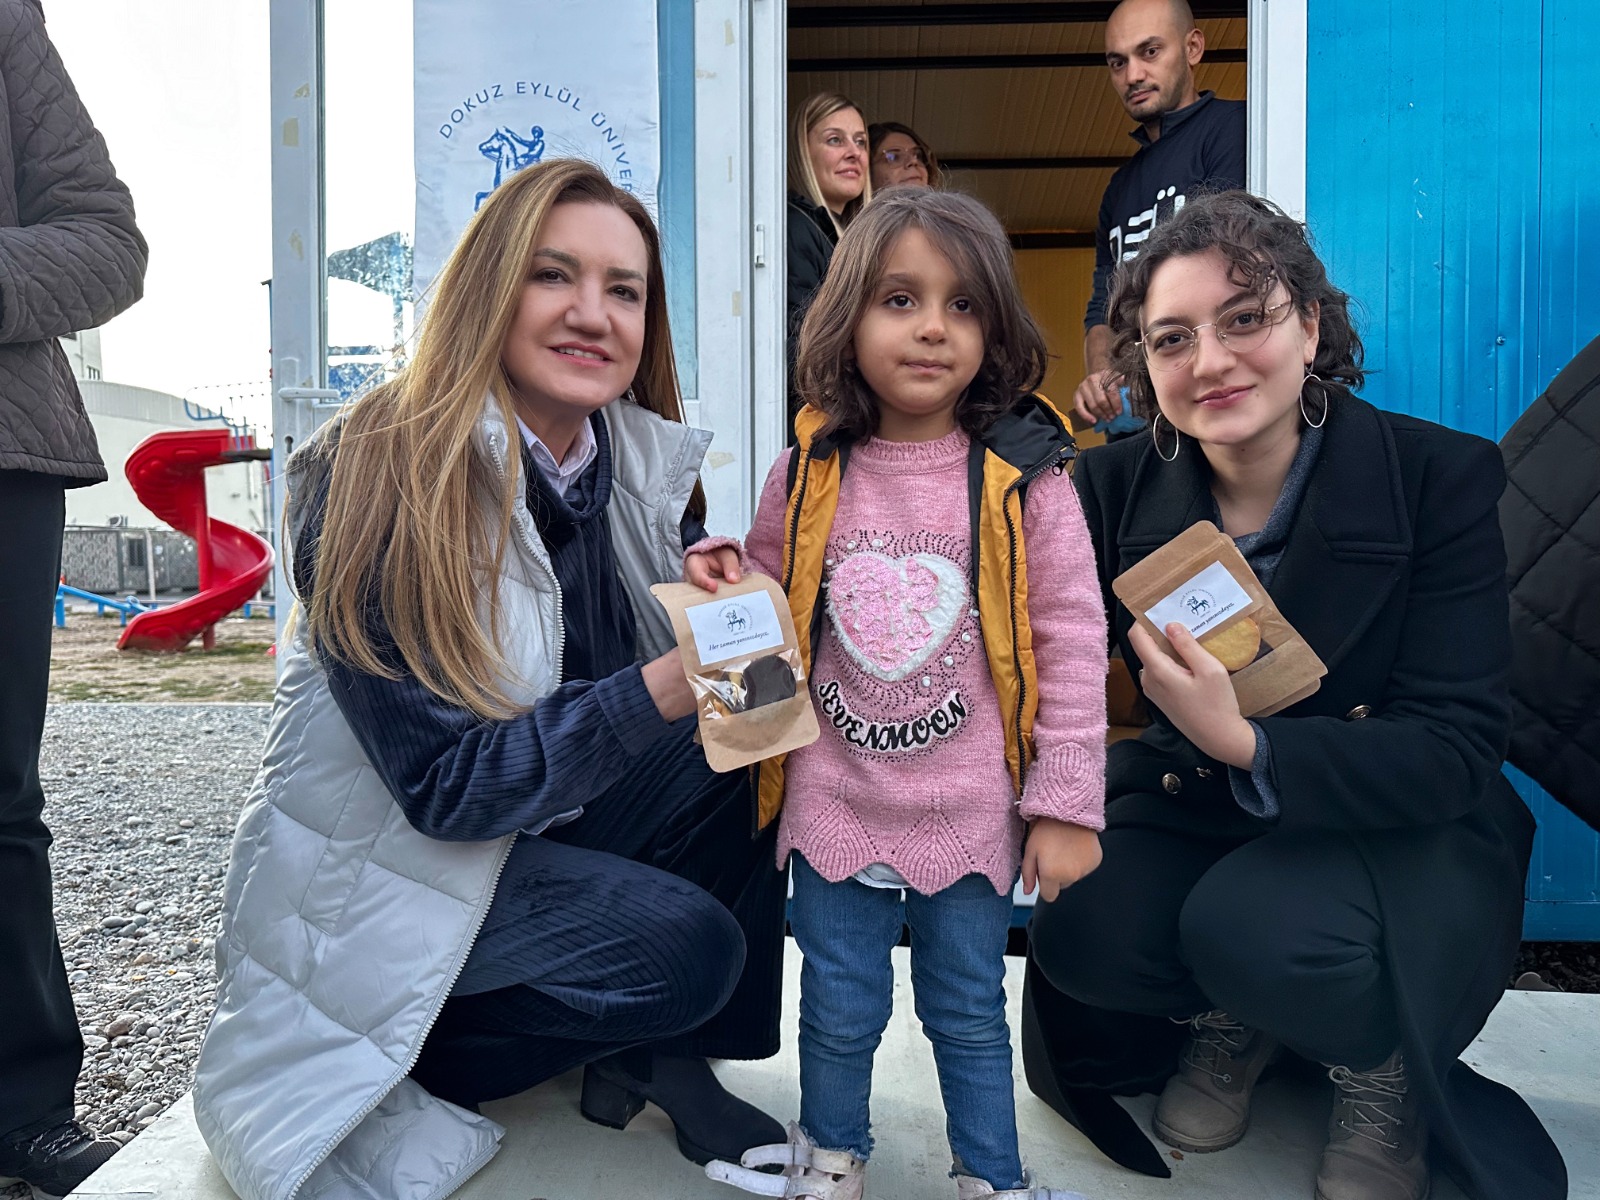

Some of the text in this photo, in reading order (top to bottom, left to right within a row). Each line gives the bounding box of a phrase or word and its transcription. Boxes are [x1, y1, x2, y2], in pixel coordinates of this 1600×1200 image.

[439, 84, 503, 139] DOKUZ
[516, 81, 581, 111] EYLÜL
[819, 681, 966, 750] SEVENMOON
